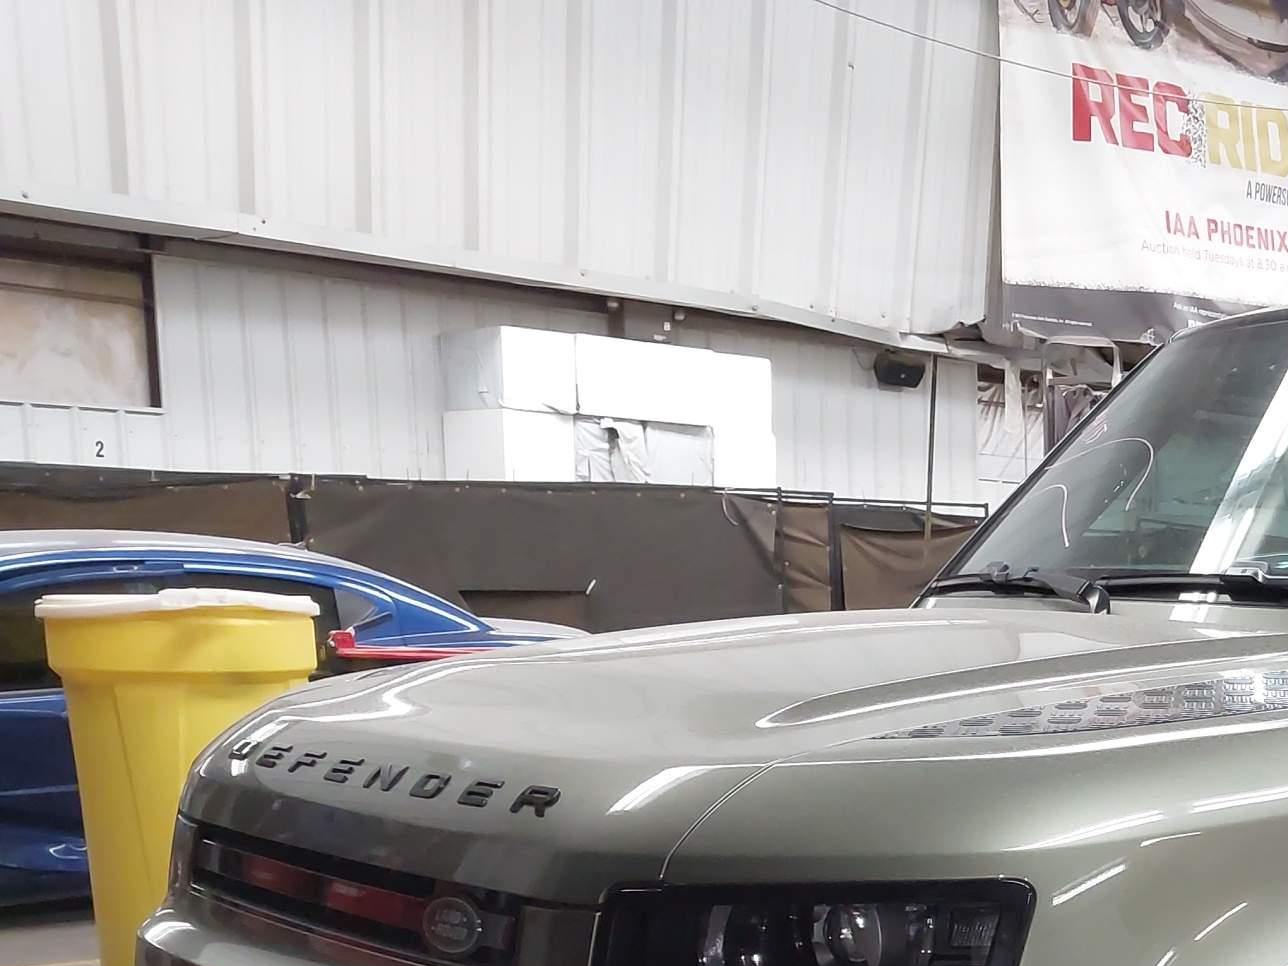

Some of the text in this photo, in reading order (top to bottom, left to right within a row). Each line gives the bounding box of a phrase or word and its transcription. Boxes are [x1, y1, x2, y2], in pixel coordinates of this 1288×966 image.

[1072, 62, 1193, 157] REC
[1246, 180, 1252, 199] A
[1165, 210, 1200, 239] IAA
[95, 440, 105, 458] 2
[229, 741, 562, 818] DEFENDER
